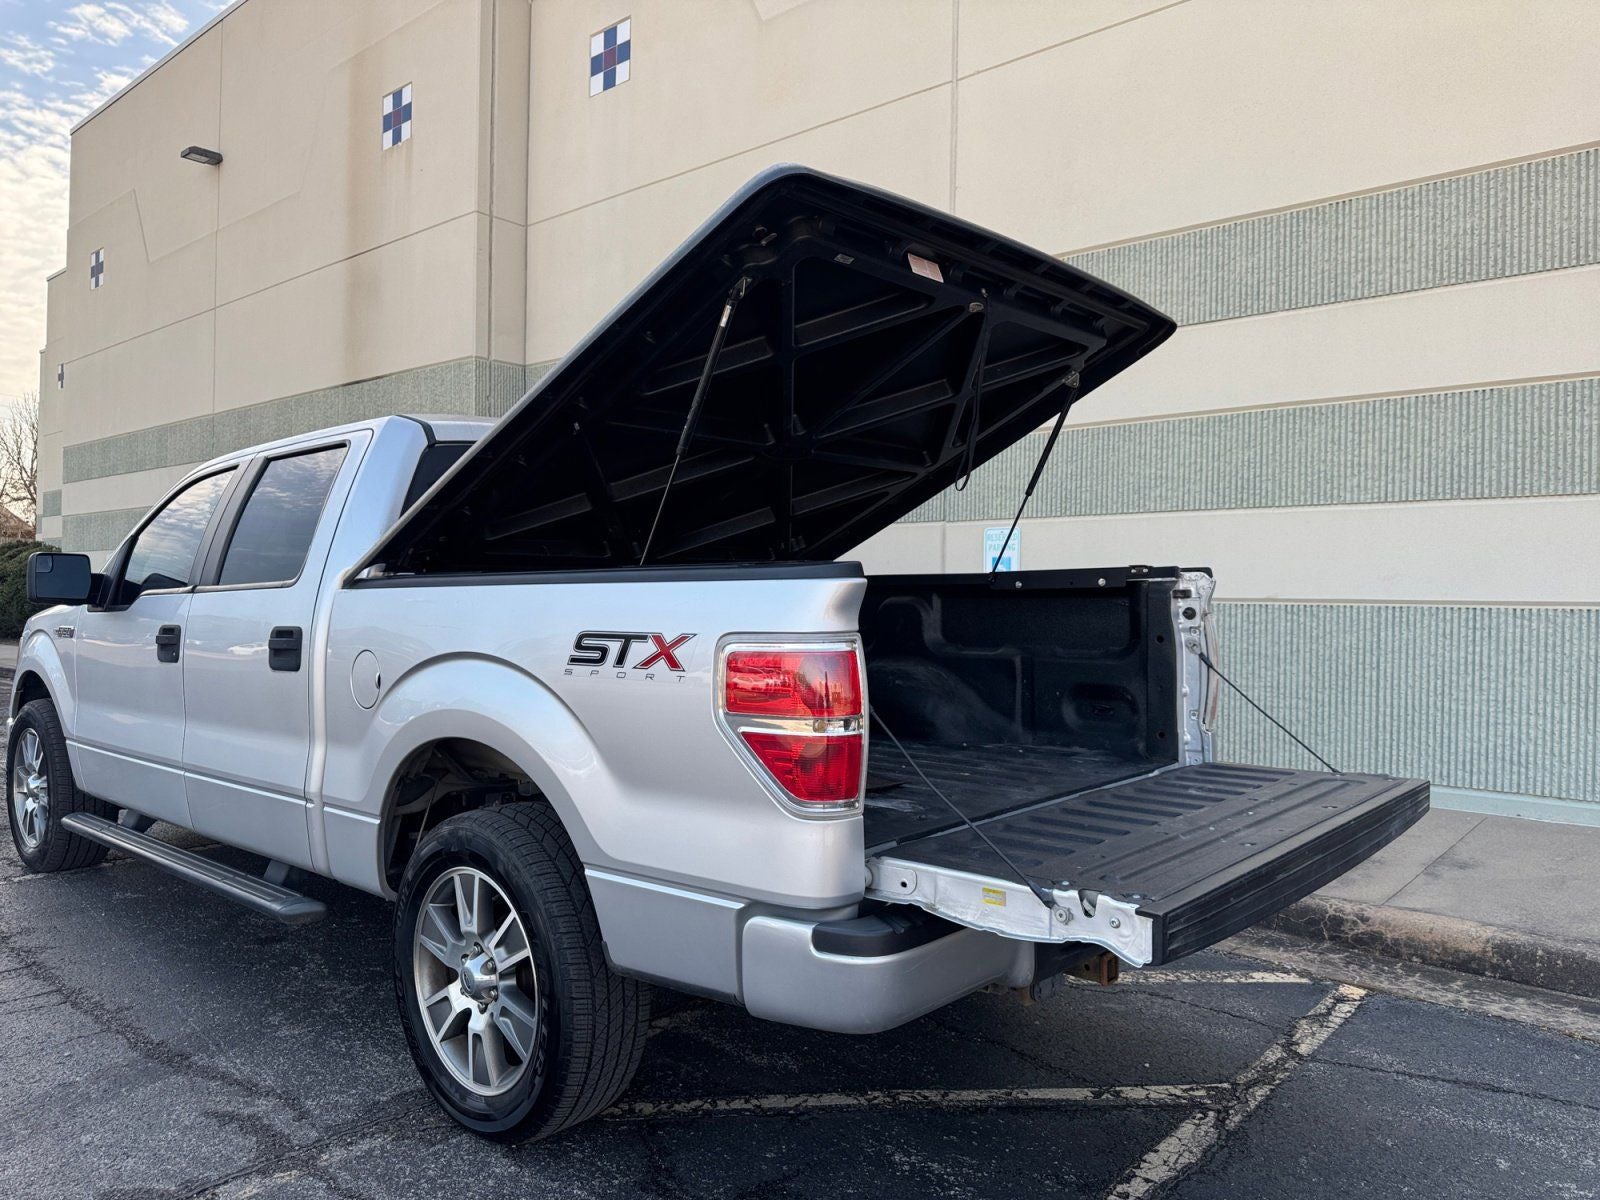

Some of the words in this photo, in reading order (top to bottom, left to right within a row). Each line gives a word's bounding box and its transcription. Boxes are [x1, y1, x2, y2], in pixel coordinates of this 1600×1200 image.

[986, 533, 1018, 541] RESERD
[988, 543, 1016, 551] PARNG
[567, 630, 698, 672] STX
[564, 668, 686, 682] SPORT
